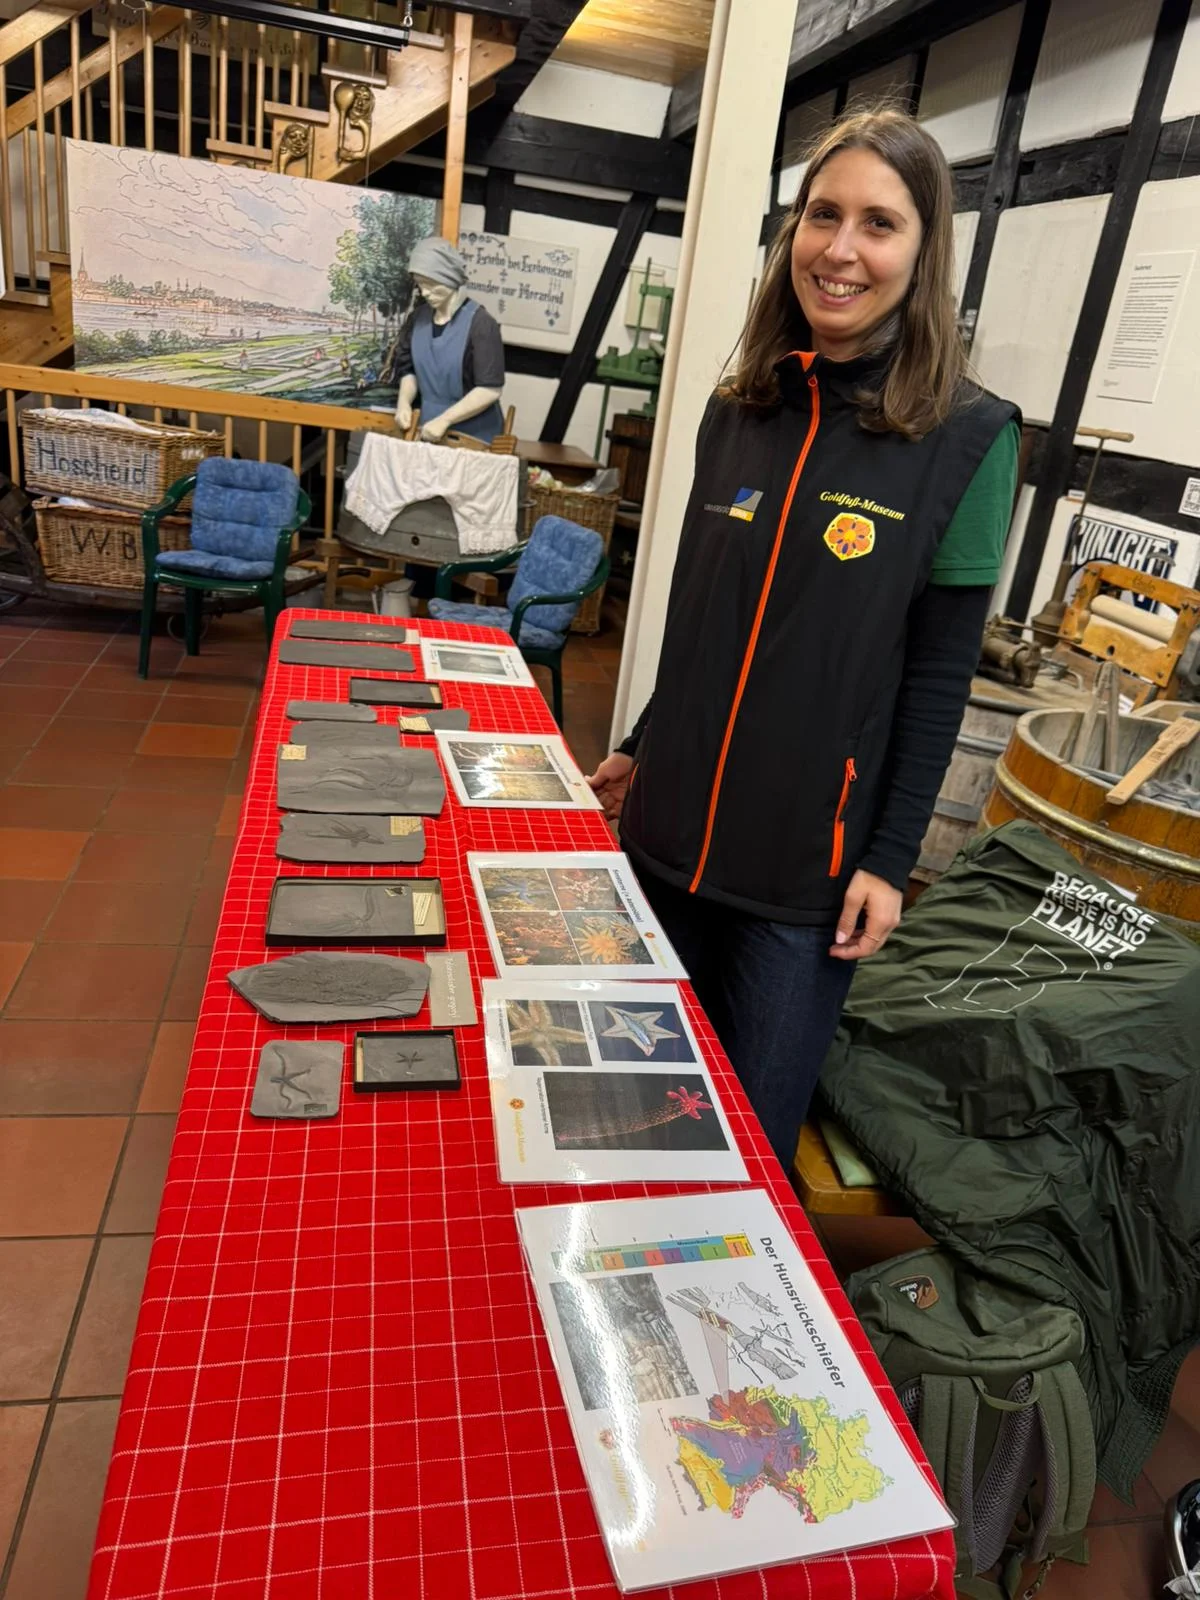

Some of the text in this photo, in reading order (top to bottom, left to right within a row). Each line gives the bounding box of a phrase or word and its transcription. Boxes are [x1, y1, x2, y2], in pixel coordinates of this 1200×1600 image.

[36, 436, 149, 485] Hoscheid
[819, 491, 905, 521] Goldfuß-Museum
[1032, 897, 1137, 960] PLANET
[1045, 886, 1146, 946] THERE IS NO
[1050, 871, 1159, 932] BECAUSE
[760, 1236, 846, 1389] Der Hunsrückschiefer
